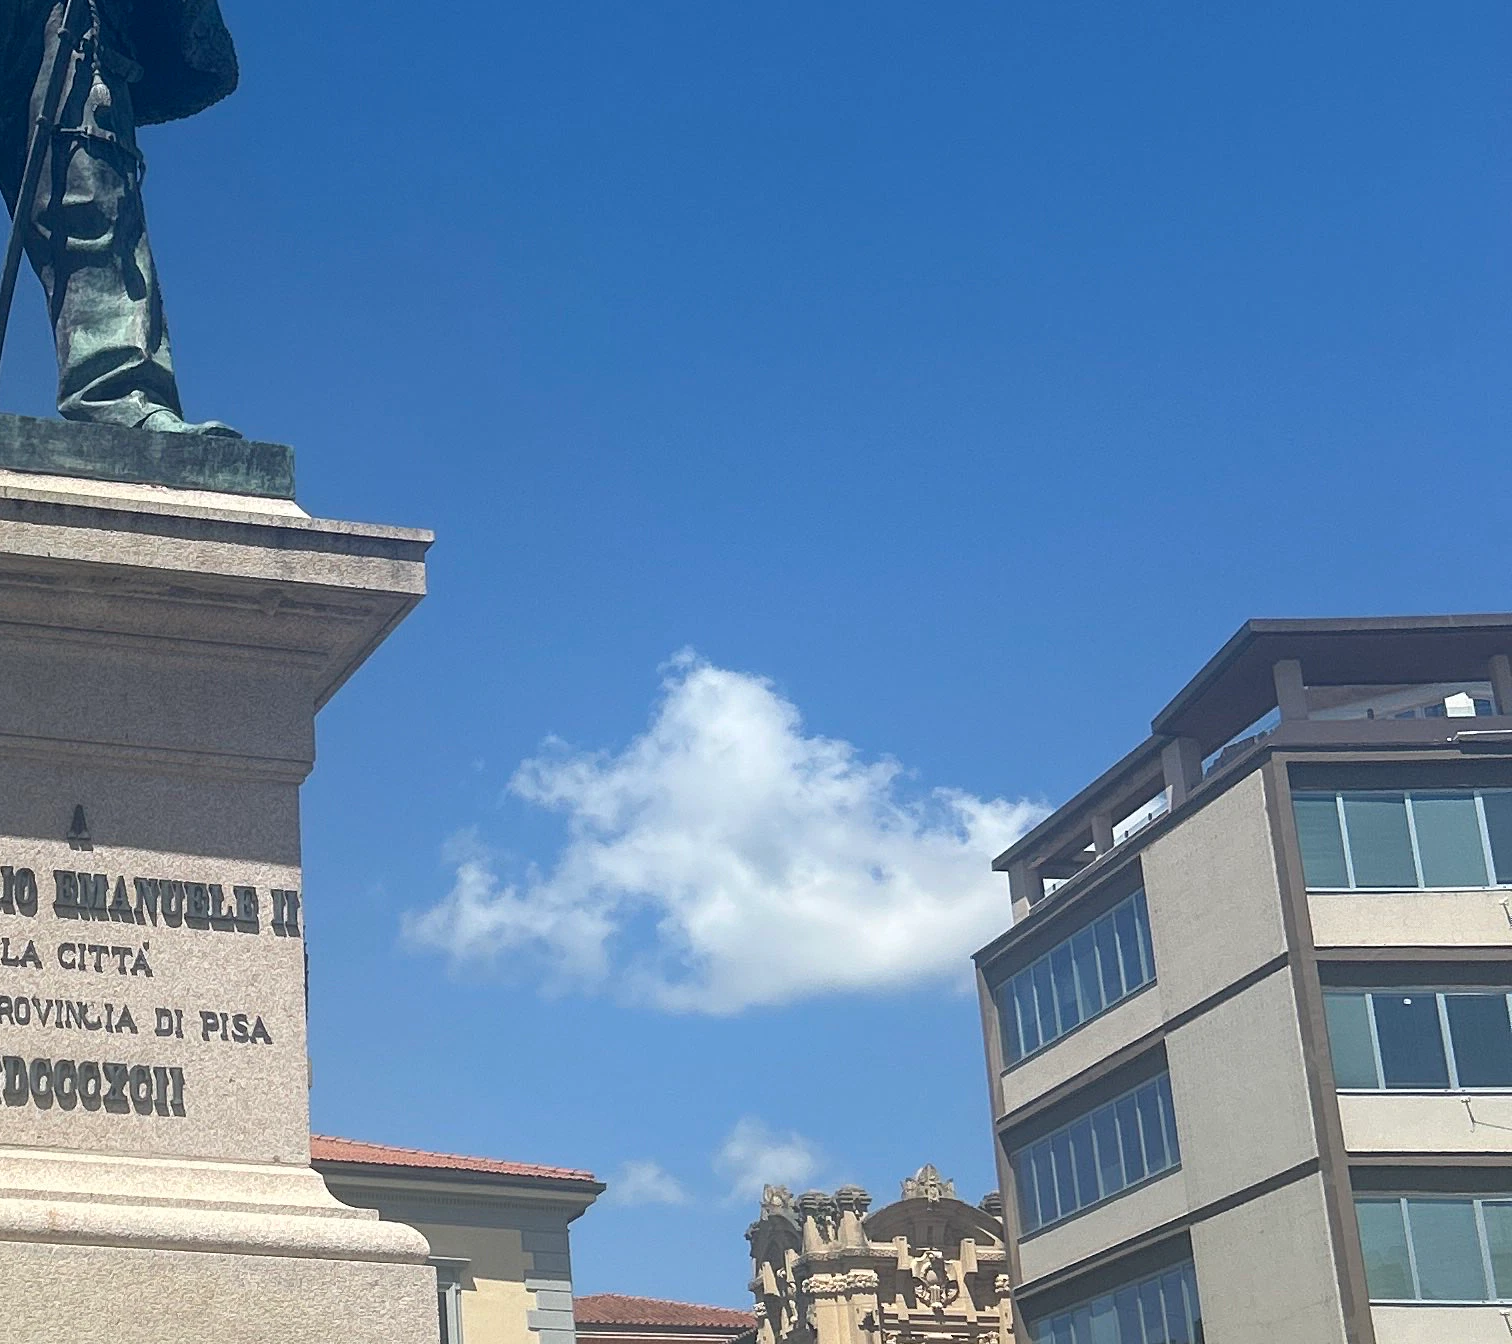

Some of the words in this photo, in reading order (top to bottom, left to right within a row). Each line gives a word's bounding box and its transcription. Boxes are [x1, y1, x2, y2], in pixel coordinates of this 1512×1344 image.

[67, 804, 94, 852] A
[53, 870, 260, 935] EMANUELE
[271, 888, 302, 938] II
[1, 937, 43, 970] LA
[154, 1007, 184, 1039] DI
[199, 1010, 273, 1045] PISA
